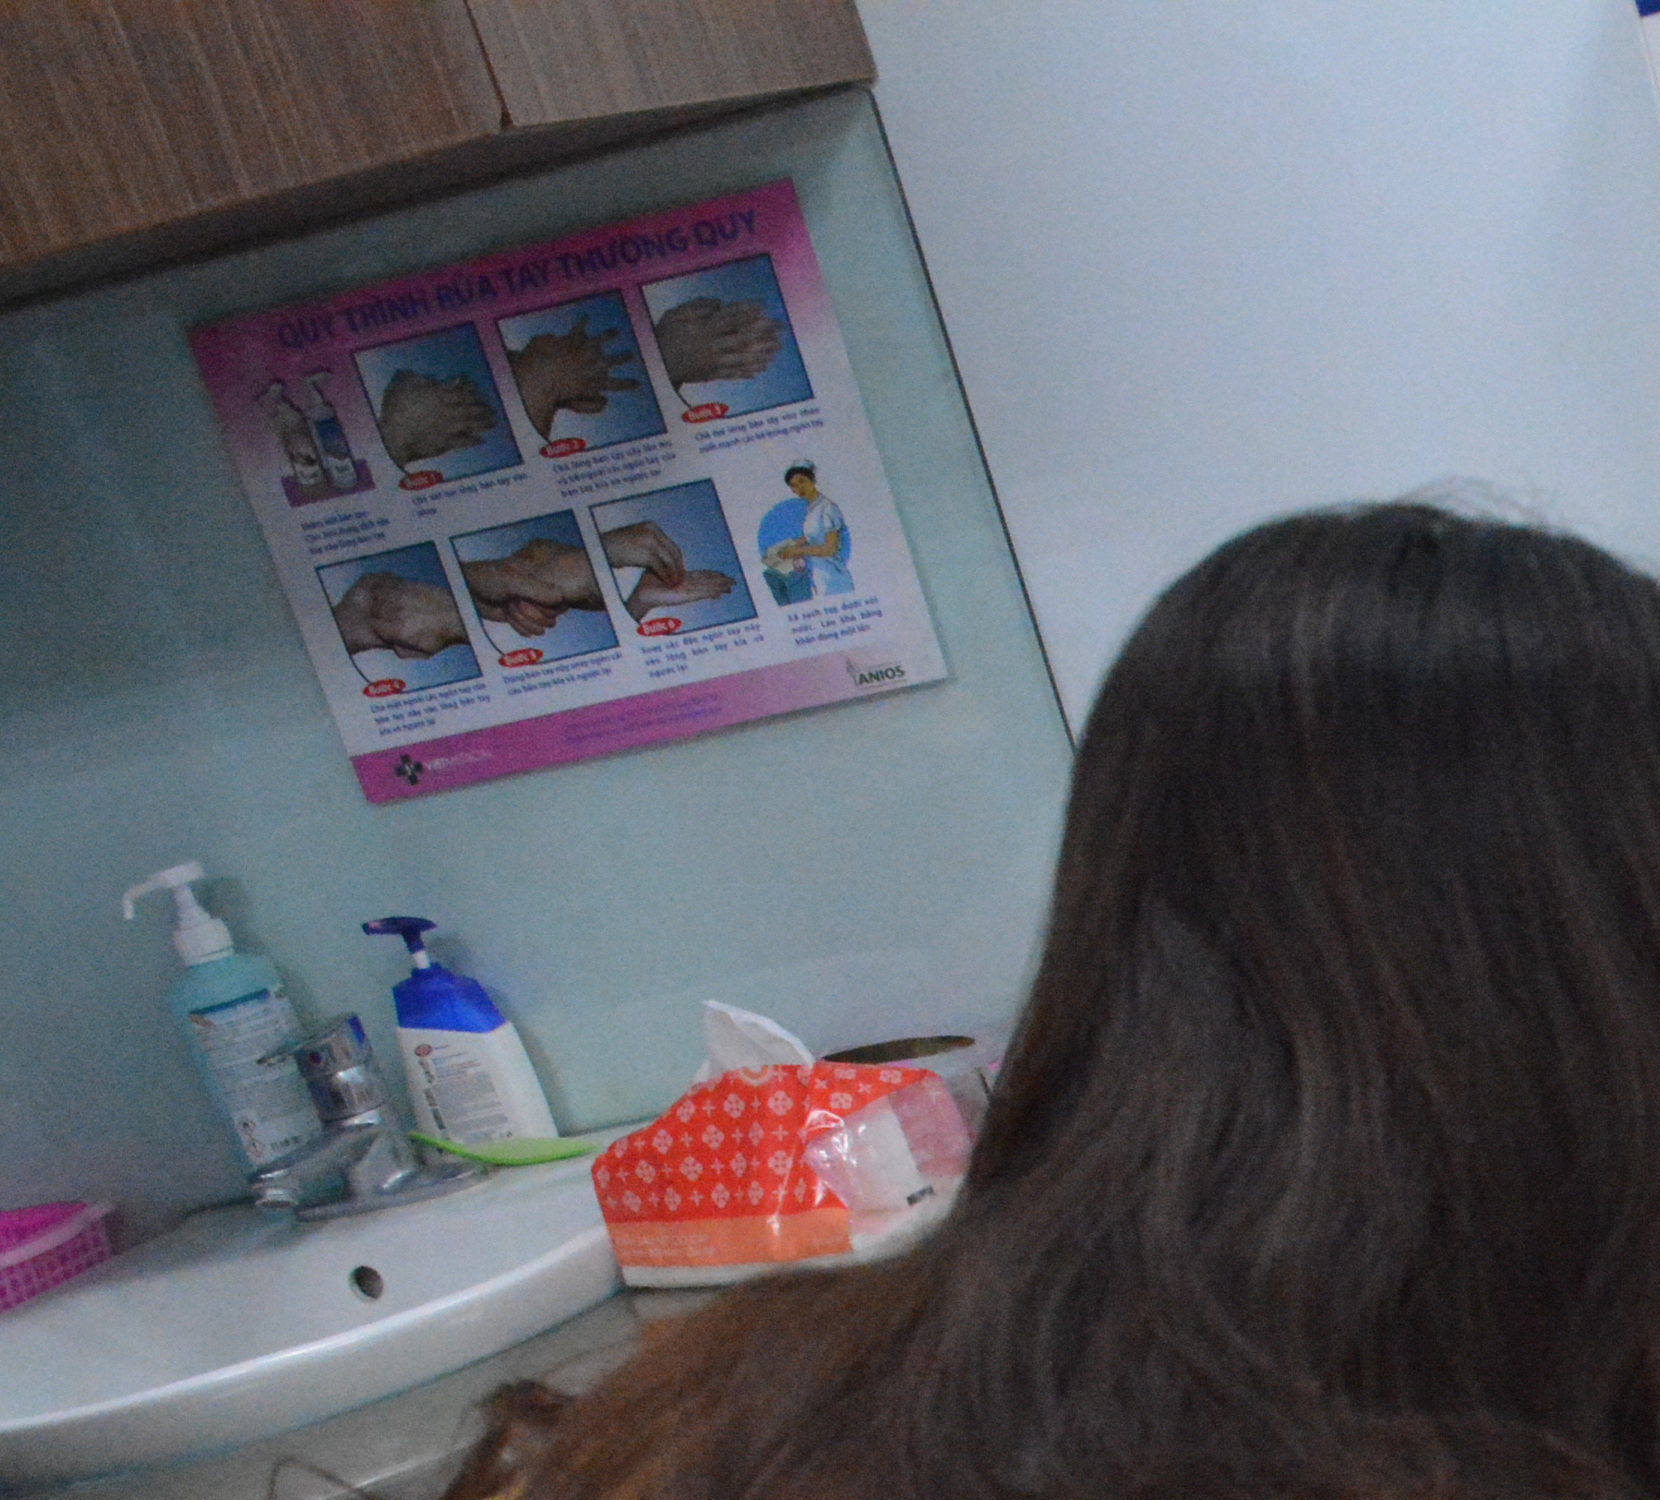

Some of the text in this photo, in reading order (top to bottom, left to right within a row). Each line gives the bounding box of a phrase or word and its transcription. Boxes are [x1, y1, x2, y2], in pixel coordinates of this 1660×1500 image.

[499, 258, 550, 294] TAY
[691, 207, 758, 248] QUY
[857, 664, 906, 685] ANIOS
